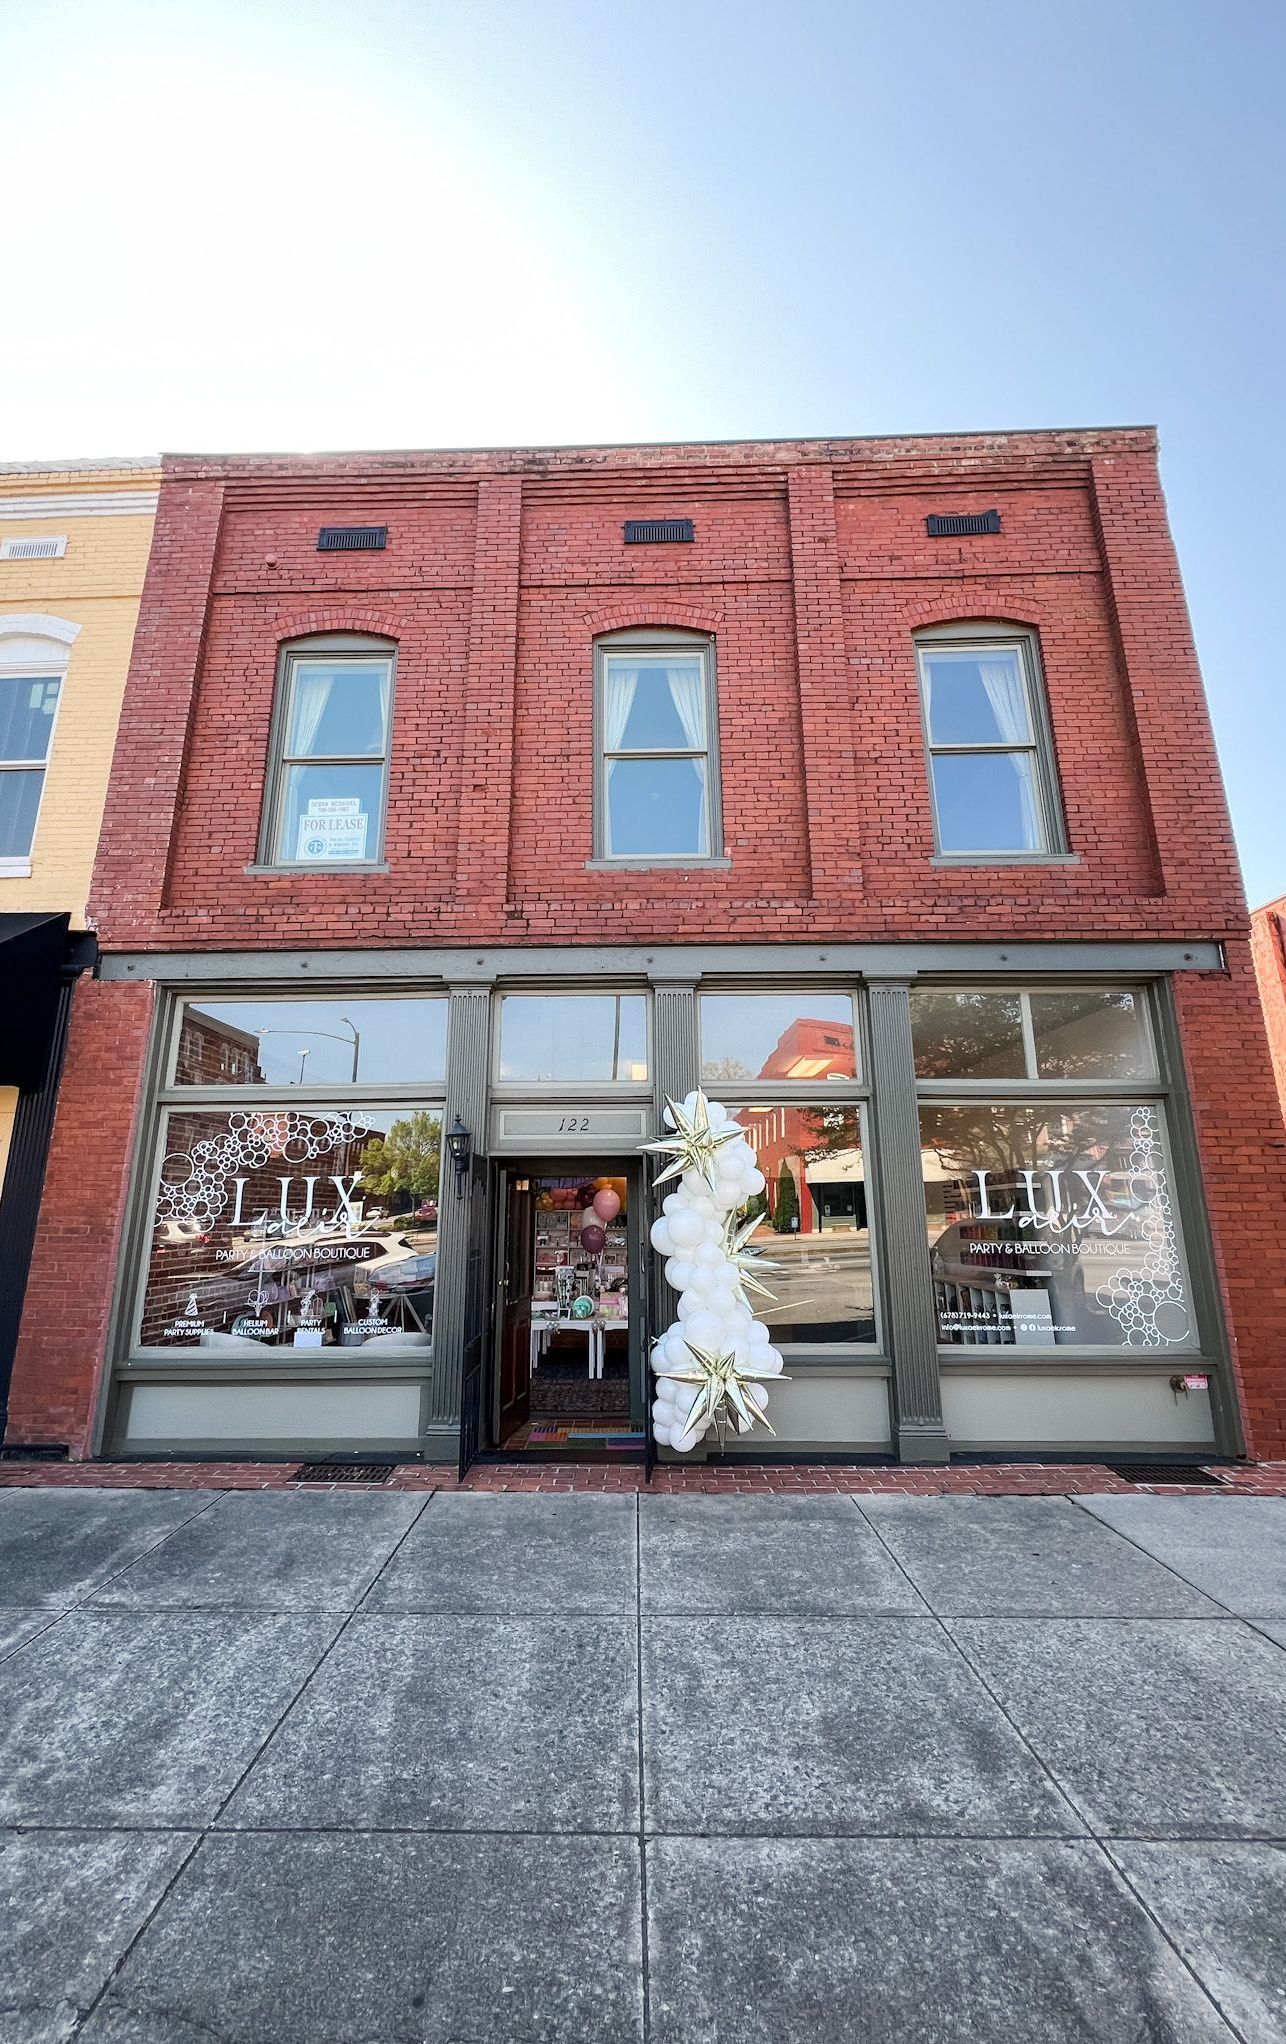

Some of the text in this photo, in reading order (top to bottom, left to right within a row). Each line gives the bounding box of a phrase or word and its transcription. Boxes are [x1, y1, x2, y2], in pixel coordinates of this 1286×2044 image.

[304, 818, 363, 831] FOR LEASE
[559, 1118, 589, 1131] 122
[227, 1175, 365, 1226] LUX
[972, 1170, 1117, 1219] LUX
[216, 1249, 247, 1260] PARTY
[259, 1248, 313, 1260] BALLOON
[314, 1247, 370, 1259] BOUTIQUE
[969, 1243, 1131, 1255] PARTY & BALLOON BOUTIQUE
[300, 1319, 322, 1327] PARTY
[358, 1318, 388, 1326] CUSTOM
[185, 1328, 214, 1336] SUPPLIES
[296, 1327, 326, 1335] RENTALS
[343, 1326, 403, 1335] BALLOON DECOR
